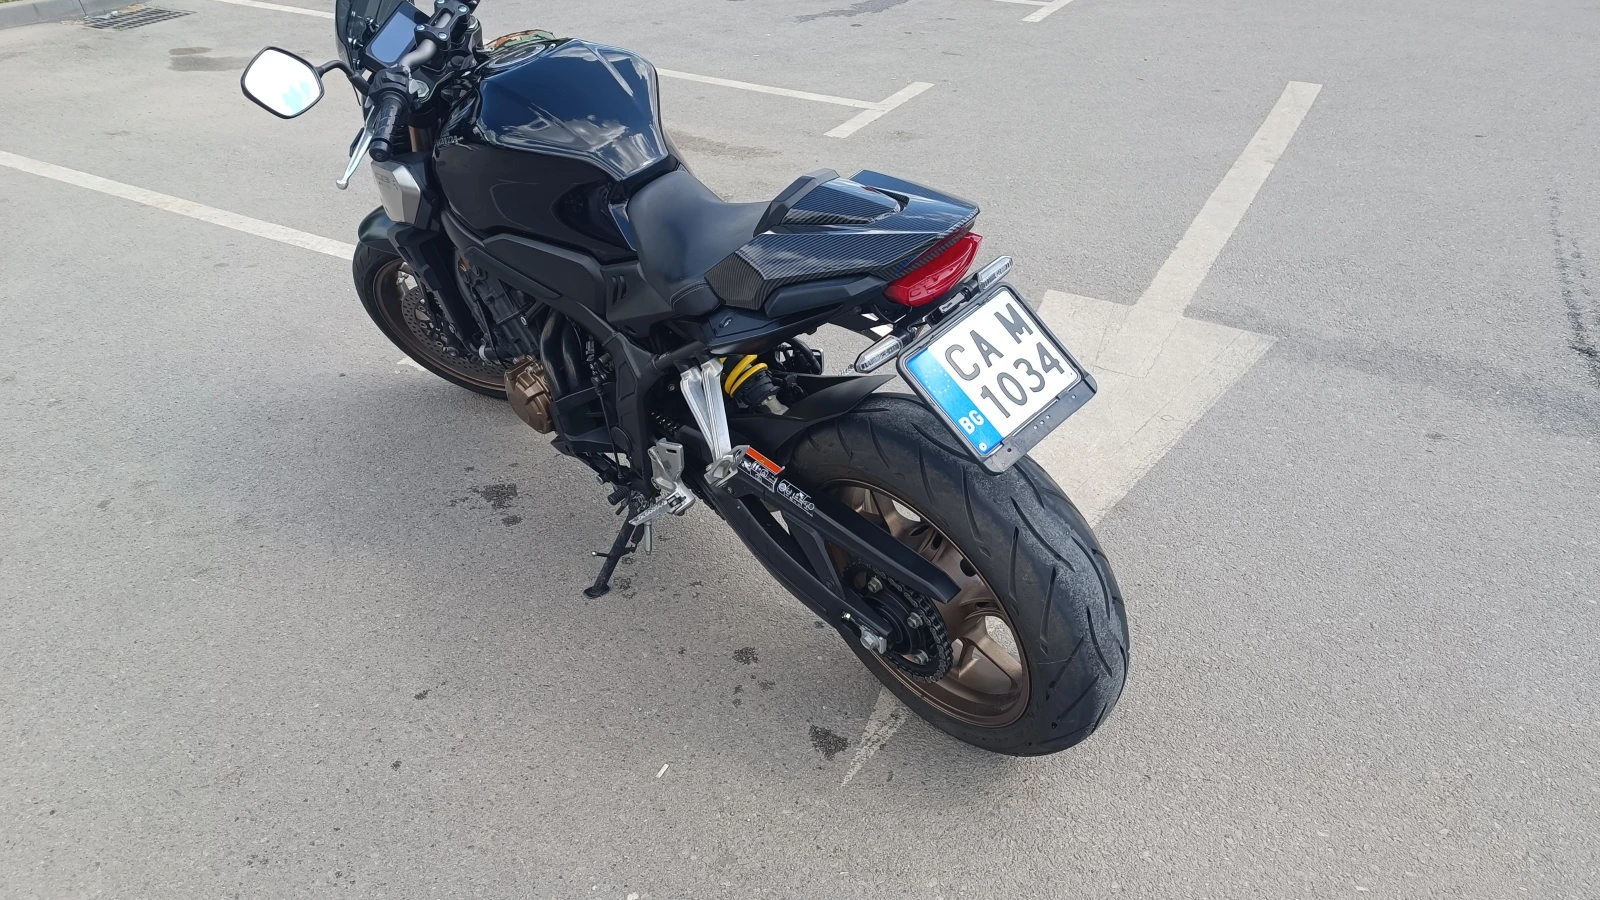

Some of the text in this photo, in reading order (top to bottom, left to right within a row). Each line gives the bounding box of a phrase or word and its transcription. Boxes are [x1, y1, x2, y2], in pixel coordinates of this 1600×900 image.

[945, 302, 1034, 381] CA M
[980, 342, 1065, 419] 1034
[958, 409, 985, 434] BG
